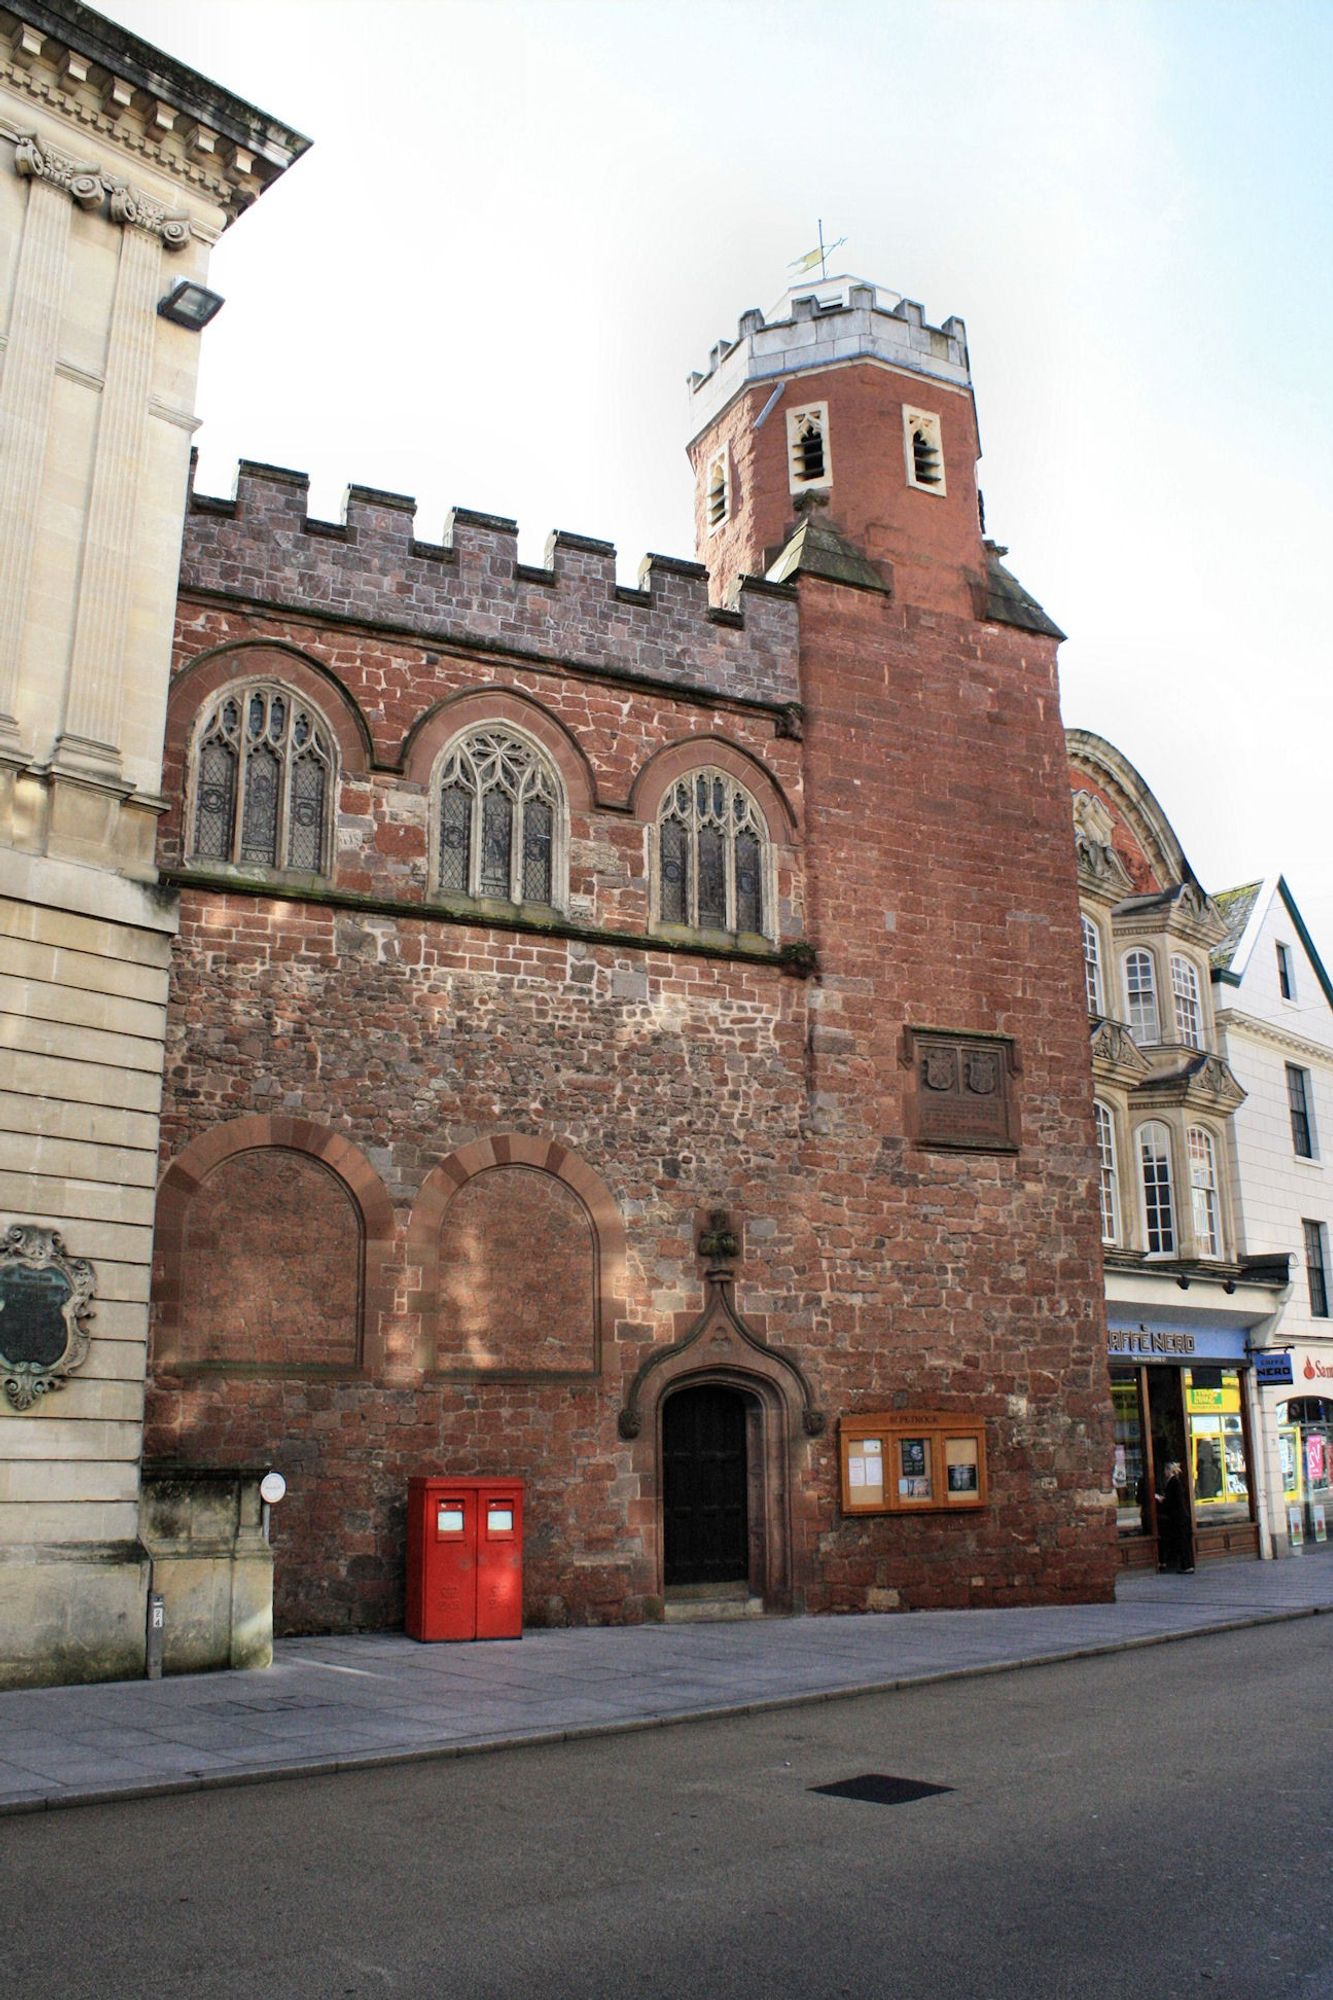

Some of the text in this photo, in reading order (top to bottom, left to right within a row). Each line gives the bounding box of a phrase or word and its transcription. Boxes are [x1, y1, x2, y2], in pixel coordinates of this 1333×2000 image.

[1107, 1324, 1195, 1353] AFFÈ NERO
[1257, 1367, 1291, 1376] NERO
